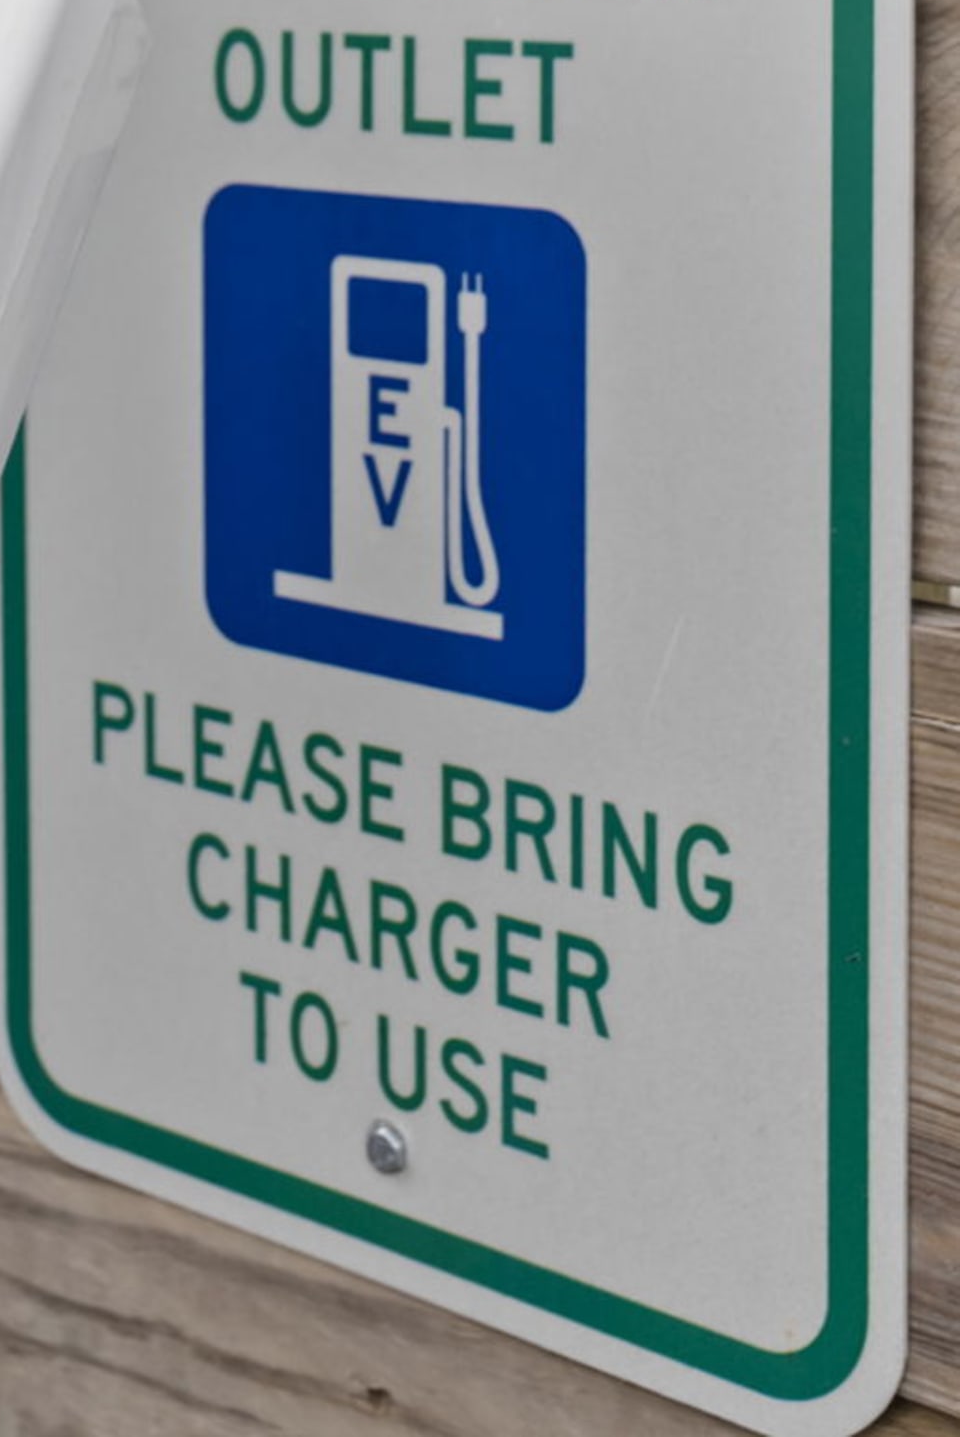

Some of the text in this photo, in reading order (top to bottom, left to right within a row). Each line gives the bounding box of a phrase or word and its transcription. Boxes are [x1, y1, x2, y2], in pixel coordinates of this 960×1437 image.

[213, 28, 575, 145] OUTLET
[362, 372, 415, 529] EV
[92, 679, 734, 927] PLEASE BRING
[186, 831, 612, 1041] CHARGER
[239, 971, 550, 1162] TO USE
